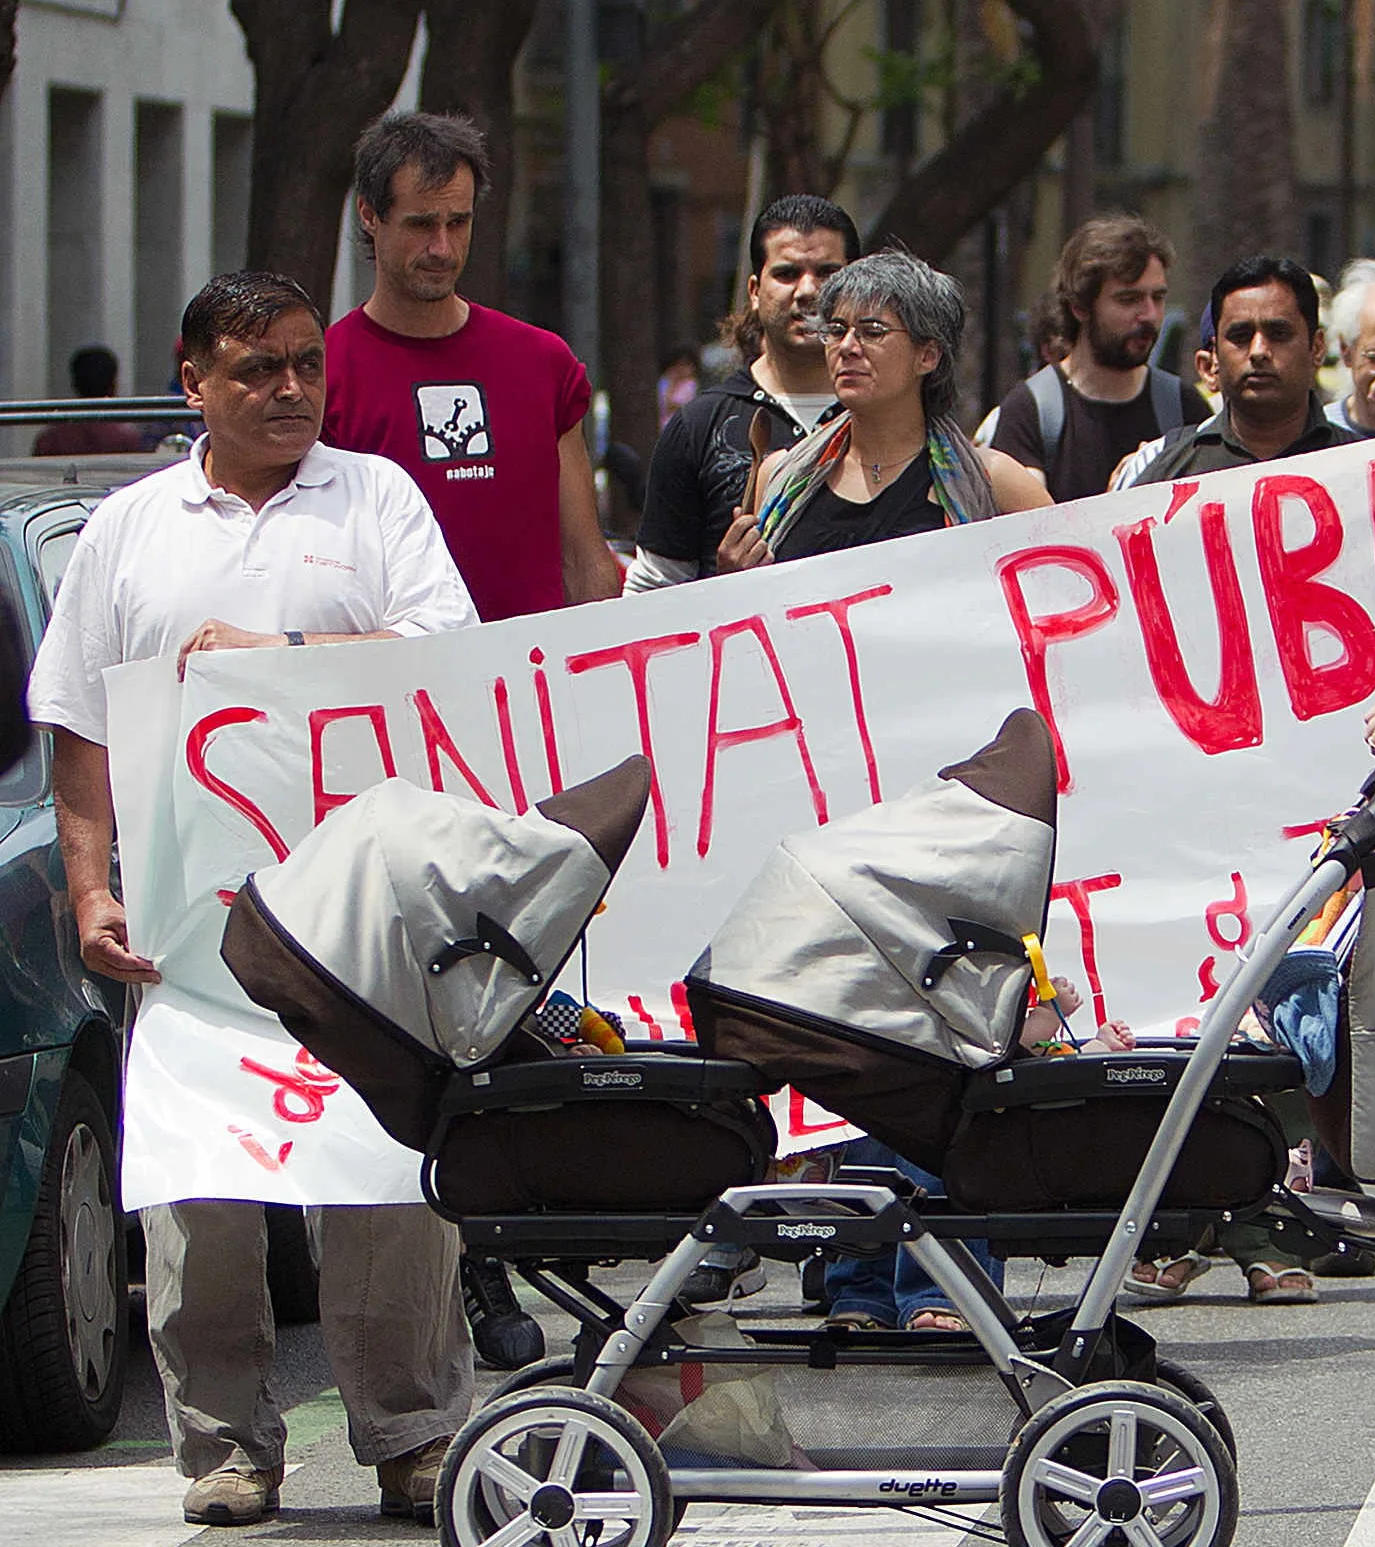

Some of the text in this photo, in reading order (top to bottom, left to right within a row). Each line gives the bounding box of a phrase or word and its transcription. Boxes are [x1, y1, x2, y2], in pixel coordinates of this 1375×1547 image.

[446, 464, 495, 481] sabotaje
[777, 1222, 836, 1239] Peg-Pérego
[878, 1478, 958, 1497] duette
